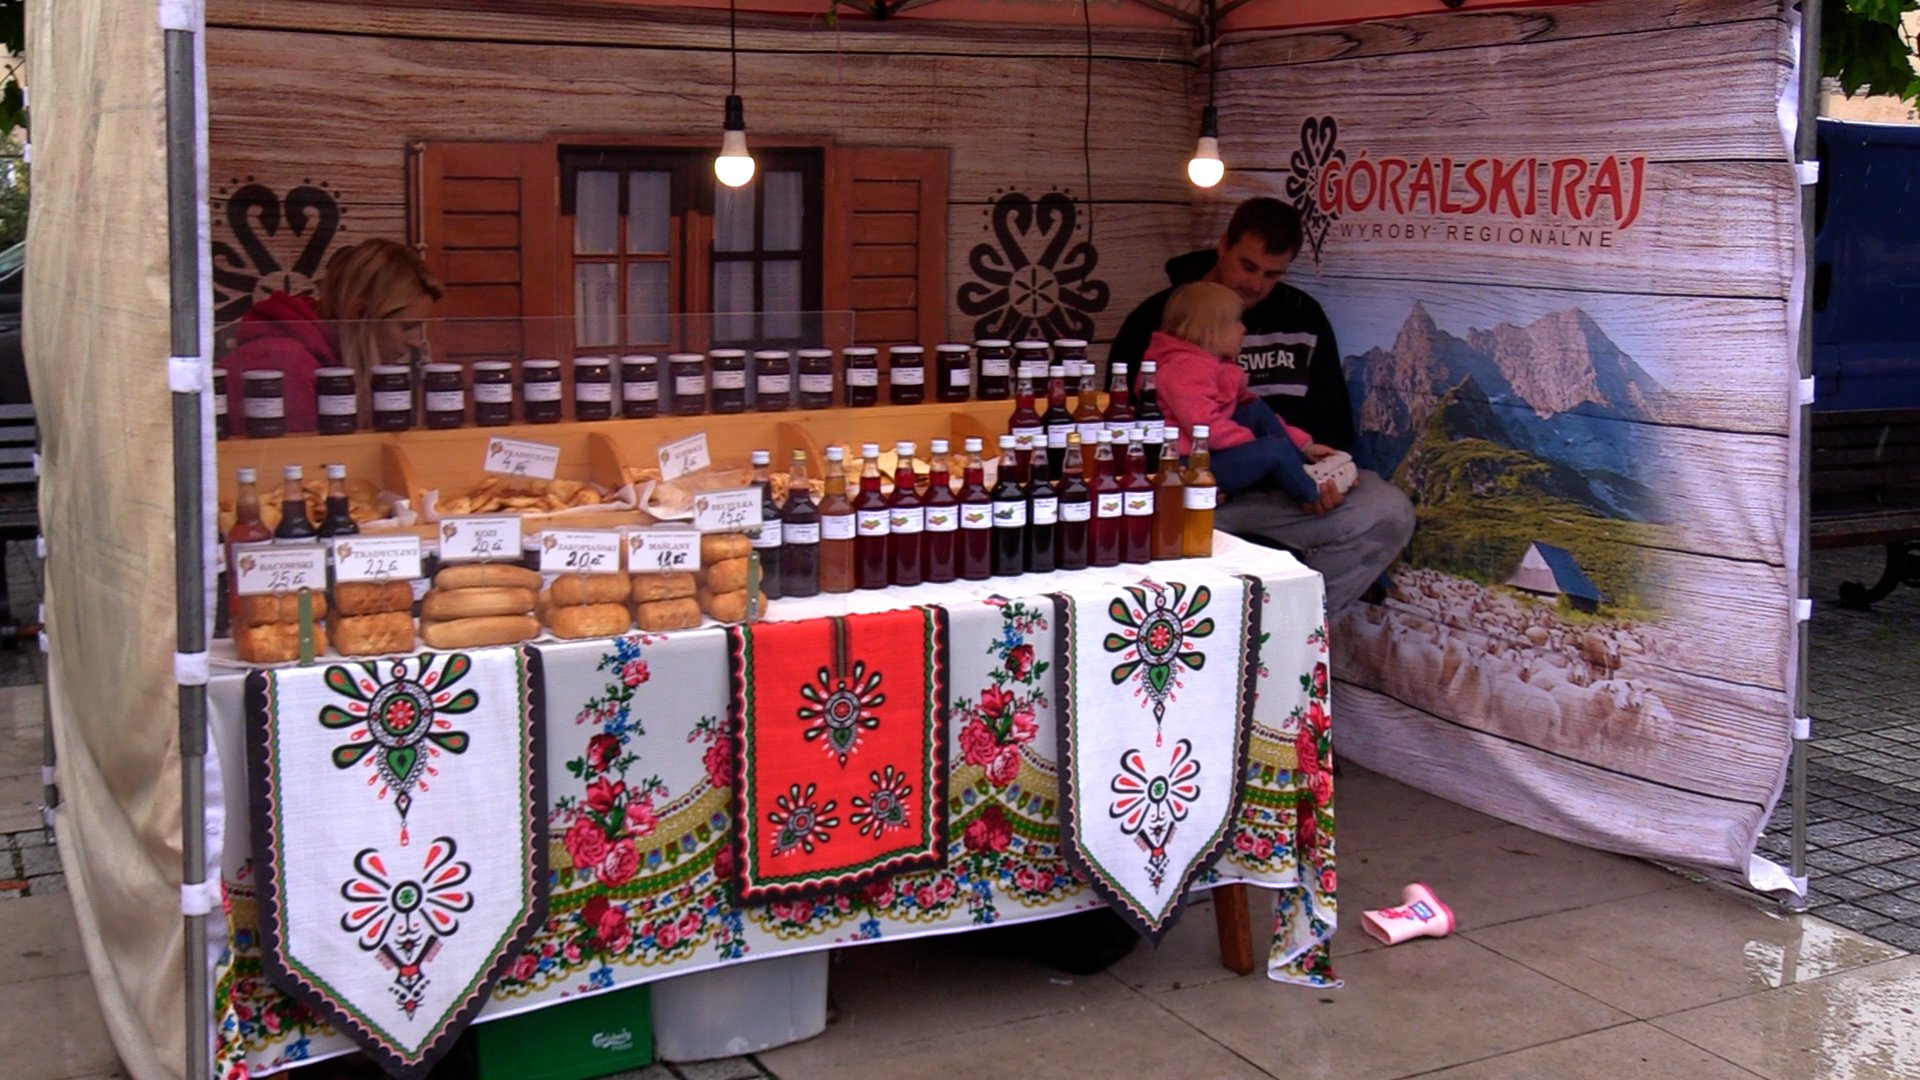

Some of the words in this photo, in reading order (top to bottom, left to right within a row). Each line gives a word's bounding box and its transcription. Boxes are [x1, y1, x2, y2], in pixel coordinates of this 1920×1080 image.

[1319, 150, 1537, 218] GÓRALSKI
[1551, 155, 1646, 230] RAJ
[1340, 223, 1431, 240] WYROBY
[1447, 226, 1614, 248] REGIONALNE
[565, 551, 590, 567] 20
